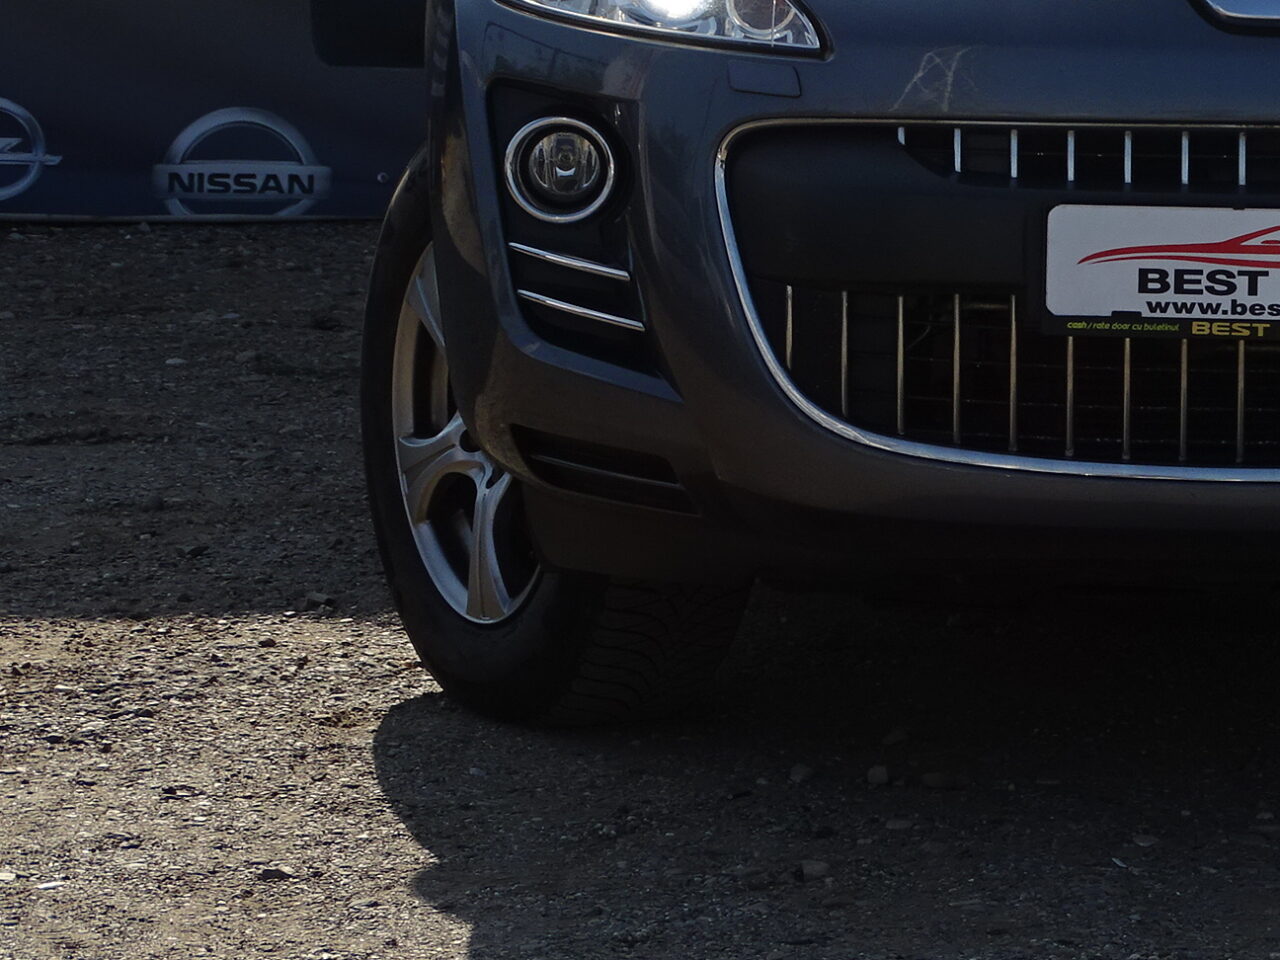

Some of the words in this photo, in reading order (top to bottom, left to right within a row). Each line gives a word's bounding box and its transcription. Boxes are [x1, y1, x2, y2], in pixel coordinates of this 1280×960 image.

[168, 172, 314, 194] NISSAN
[1137, 268, 1269, 296] BEST
[1191, 321, 1270, 337] BEST
